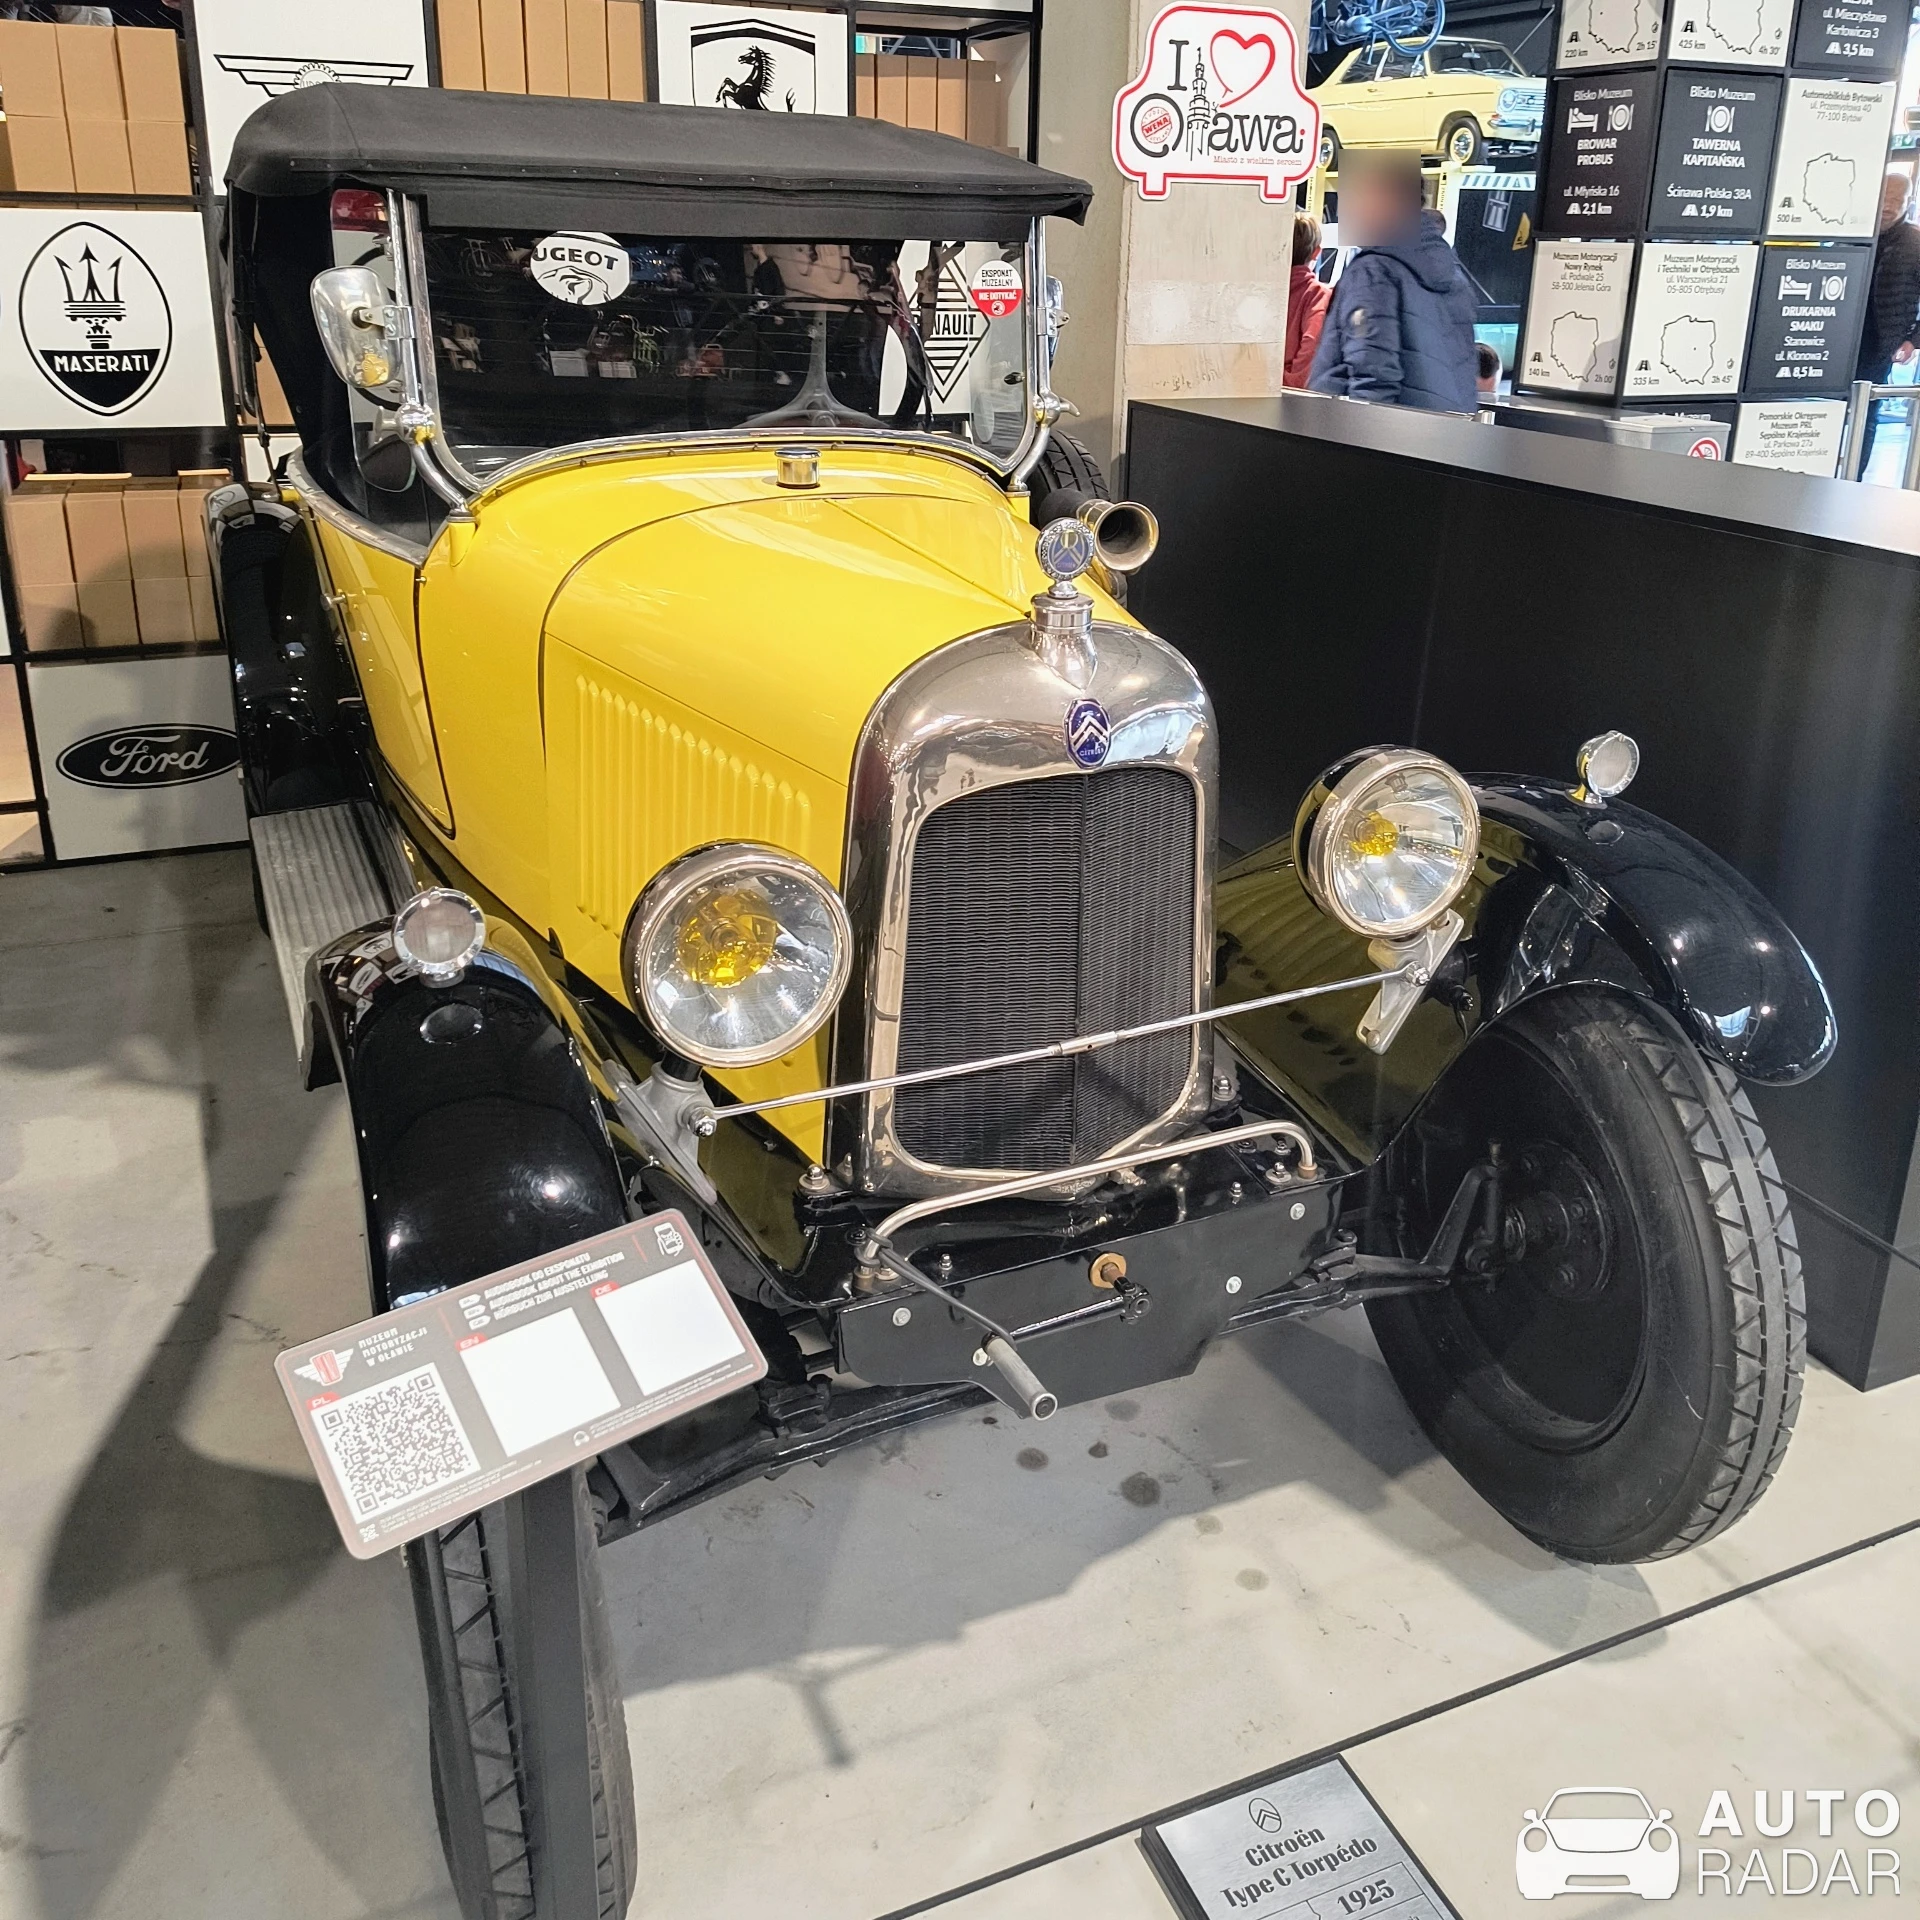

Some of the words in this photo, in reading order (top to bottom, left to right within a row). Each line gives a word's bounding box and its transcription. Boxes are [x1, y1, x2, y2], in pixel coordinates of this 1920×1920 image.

[1872, 27, 1879, 38] 3
[1678, 40, 1692, 49] 425
[1694, 41, 1706, 50] km
[1842, 44, 1858, 57] 3,5
[1858, 44, 1874, 57] km
[1565, 50, 1577, 58] 220
[1167, 39, 1189, 91] I
[1574, 90, 1596, 101] Blisko
[1598, 88, 1632, 99] Muzeum
[1690, 86, 1716, 98] Blisko
[1718, 88, 1756, 100] Muzeum
[1816, 112, 1840, 122] 77-100
[1144, 116, 1169, 134] WENA
[1577, 138, 1617, 150] BROWAR
[1692, 138, 1741, 152] TAWERNA
[1577, 154, 1613, 166] PROBUS
[1682, 153, 1745, 168] KAPITAŃSKA
[1564, 186, 1573, 196] ul.
[1608, 185, 1620, 196] 16
[1666, 183, 1702, 198] Ścinawa
[1704, 187, 1732, 200] Polska
[1733, 188, 1752, 200] 38A
[1582, 202, 1596, 216] 2,1
[1597, 202, 1612, 214] km
[1700, 204, 1716, 218] 1,9
[1716, 205, 1733, 218] km
[1776, 214, 1790, 222] 500
[1790, 214, 1802, 222] km
[532, 247, 618, 270] UGEOT
[1552, 252, 1579, 260] Muzeum
[1580, 252, 1618, 263] Motoryzacji
[1664, 254, 1694, 264] Muzeum
[1696, 255, 1738, 265] Motoryzacji
[1564, 263, 1582, 272] Nowy
[1583, 263, 1602, 272] Rynek
[1662, 264, 1691, 274] Techniki
[1786, 258, 1810, 270] Blisko
[1811, 260, 1846, 270] Muzeum
[981, 270, 1013, 278] EKSPONAT
[1676, 275, 1718, 284] Warszawska
[1719, 276, 1728, 284] 21
[1574, 282, 1594, 292] Jelenia
[1596, 282, 1612, 292] Góra
[978, 292, 990, 300] NIE
[990, 290, 1017, 300] DOTYKAĆ
[1782, 306, 1836, 317] DRUKARNIA
[912, 313, 976, 335] NAULT
[1790, 320, 1824, 332] SMAKU
[1784, 336, 1826, 346] Stanowice
[1775, 350, 1786, 360] ul.
[1786, 350, 1822, 361] Klonowa
[1822, 350, 1830, 360] 2
[54, 354, 150, 372] MASERATI
[1528, 368, 1540, 376] 140
[1540, 368, 1550, 377] km
[1594, 374, 1602, 383] 2h
[1792, 366, 1808, 379] 8,5
[1808, 366, 1823, 378] km
[1632, 378, 1647, 386] 335
[1648, 378, 1660, 386] km
[1758, 412, 1793, 420] Pomorskie
[1770, 421, 1799, 430] Muzeum
[1800, 421, 1812, 429] PRL
[1787, 431, 1820, 440] Krajeńskie
[1772, 440, 1800, 448] Parkowa
[100, 735, 209, 777] Ford
[538, 1274, 565, 1291] ABOUT
[565, 1268, 582, 1281] THE
[581, 1252, 626, 1274] EXHIBITION
[554, 1270, 609, 1298] AUSSTELLUNG
[594, 1285, 613, 1296] DE
[358, 1328, 398, 1349] MUZEUM
[362, 1326, 428, 1358] MOTORYZACJI
[460, 1336, 479, 1350] EN
[366, 1358, 376, 1368] W
[378, 1342, 414, 1362] OŁAWIE
[312, 1396, 332, 1408] PL
[1244, 1828, 1326, 1867] Citroën
[1220, 1877, 1275, 1908] Type
[1272, 1867, 1291, 1888] C
[1288, 1837, 1378, 1881] Torpédo
[1337, 1878, 1395, 1916] 1925
